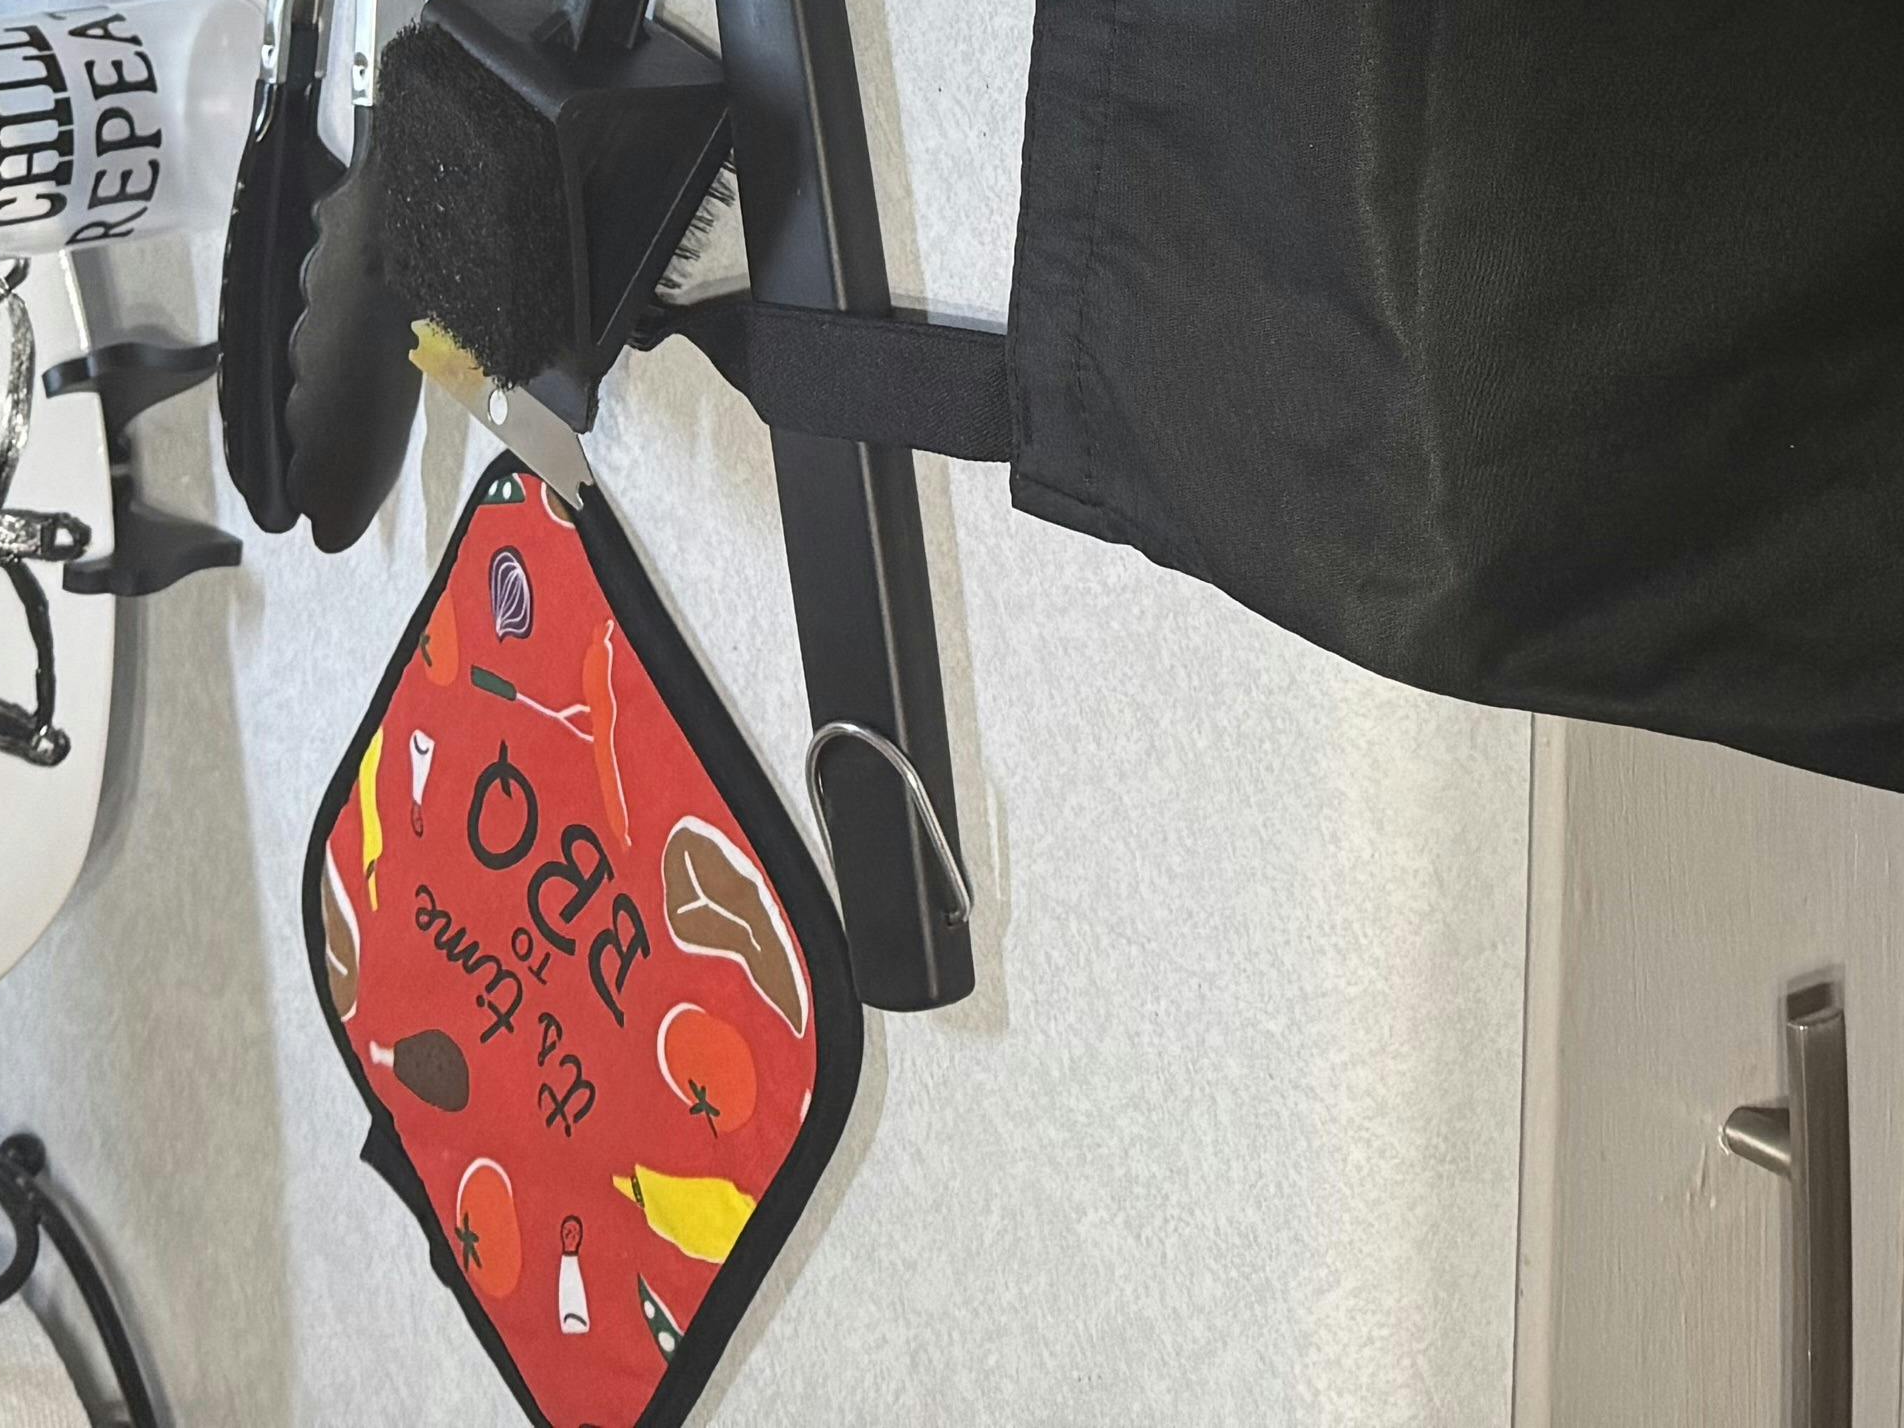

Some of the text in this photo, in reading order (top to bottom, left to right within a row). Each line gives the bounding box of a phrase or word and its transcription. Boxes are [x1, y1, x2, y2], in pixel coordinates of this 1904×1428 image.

[467, 739, 650, 1028] BBQ
[511, 927, 552, 984] TO
[414, 884, 595, 1137] it's time
